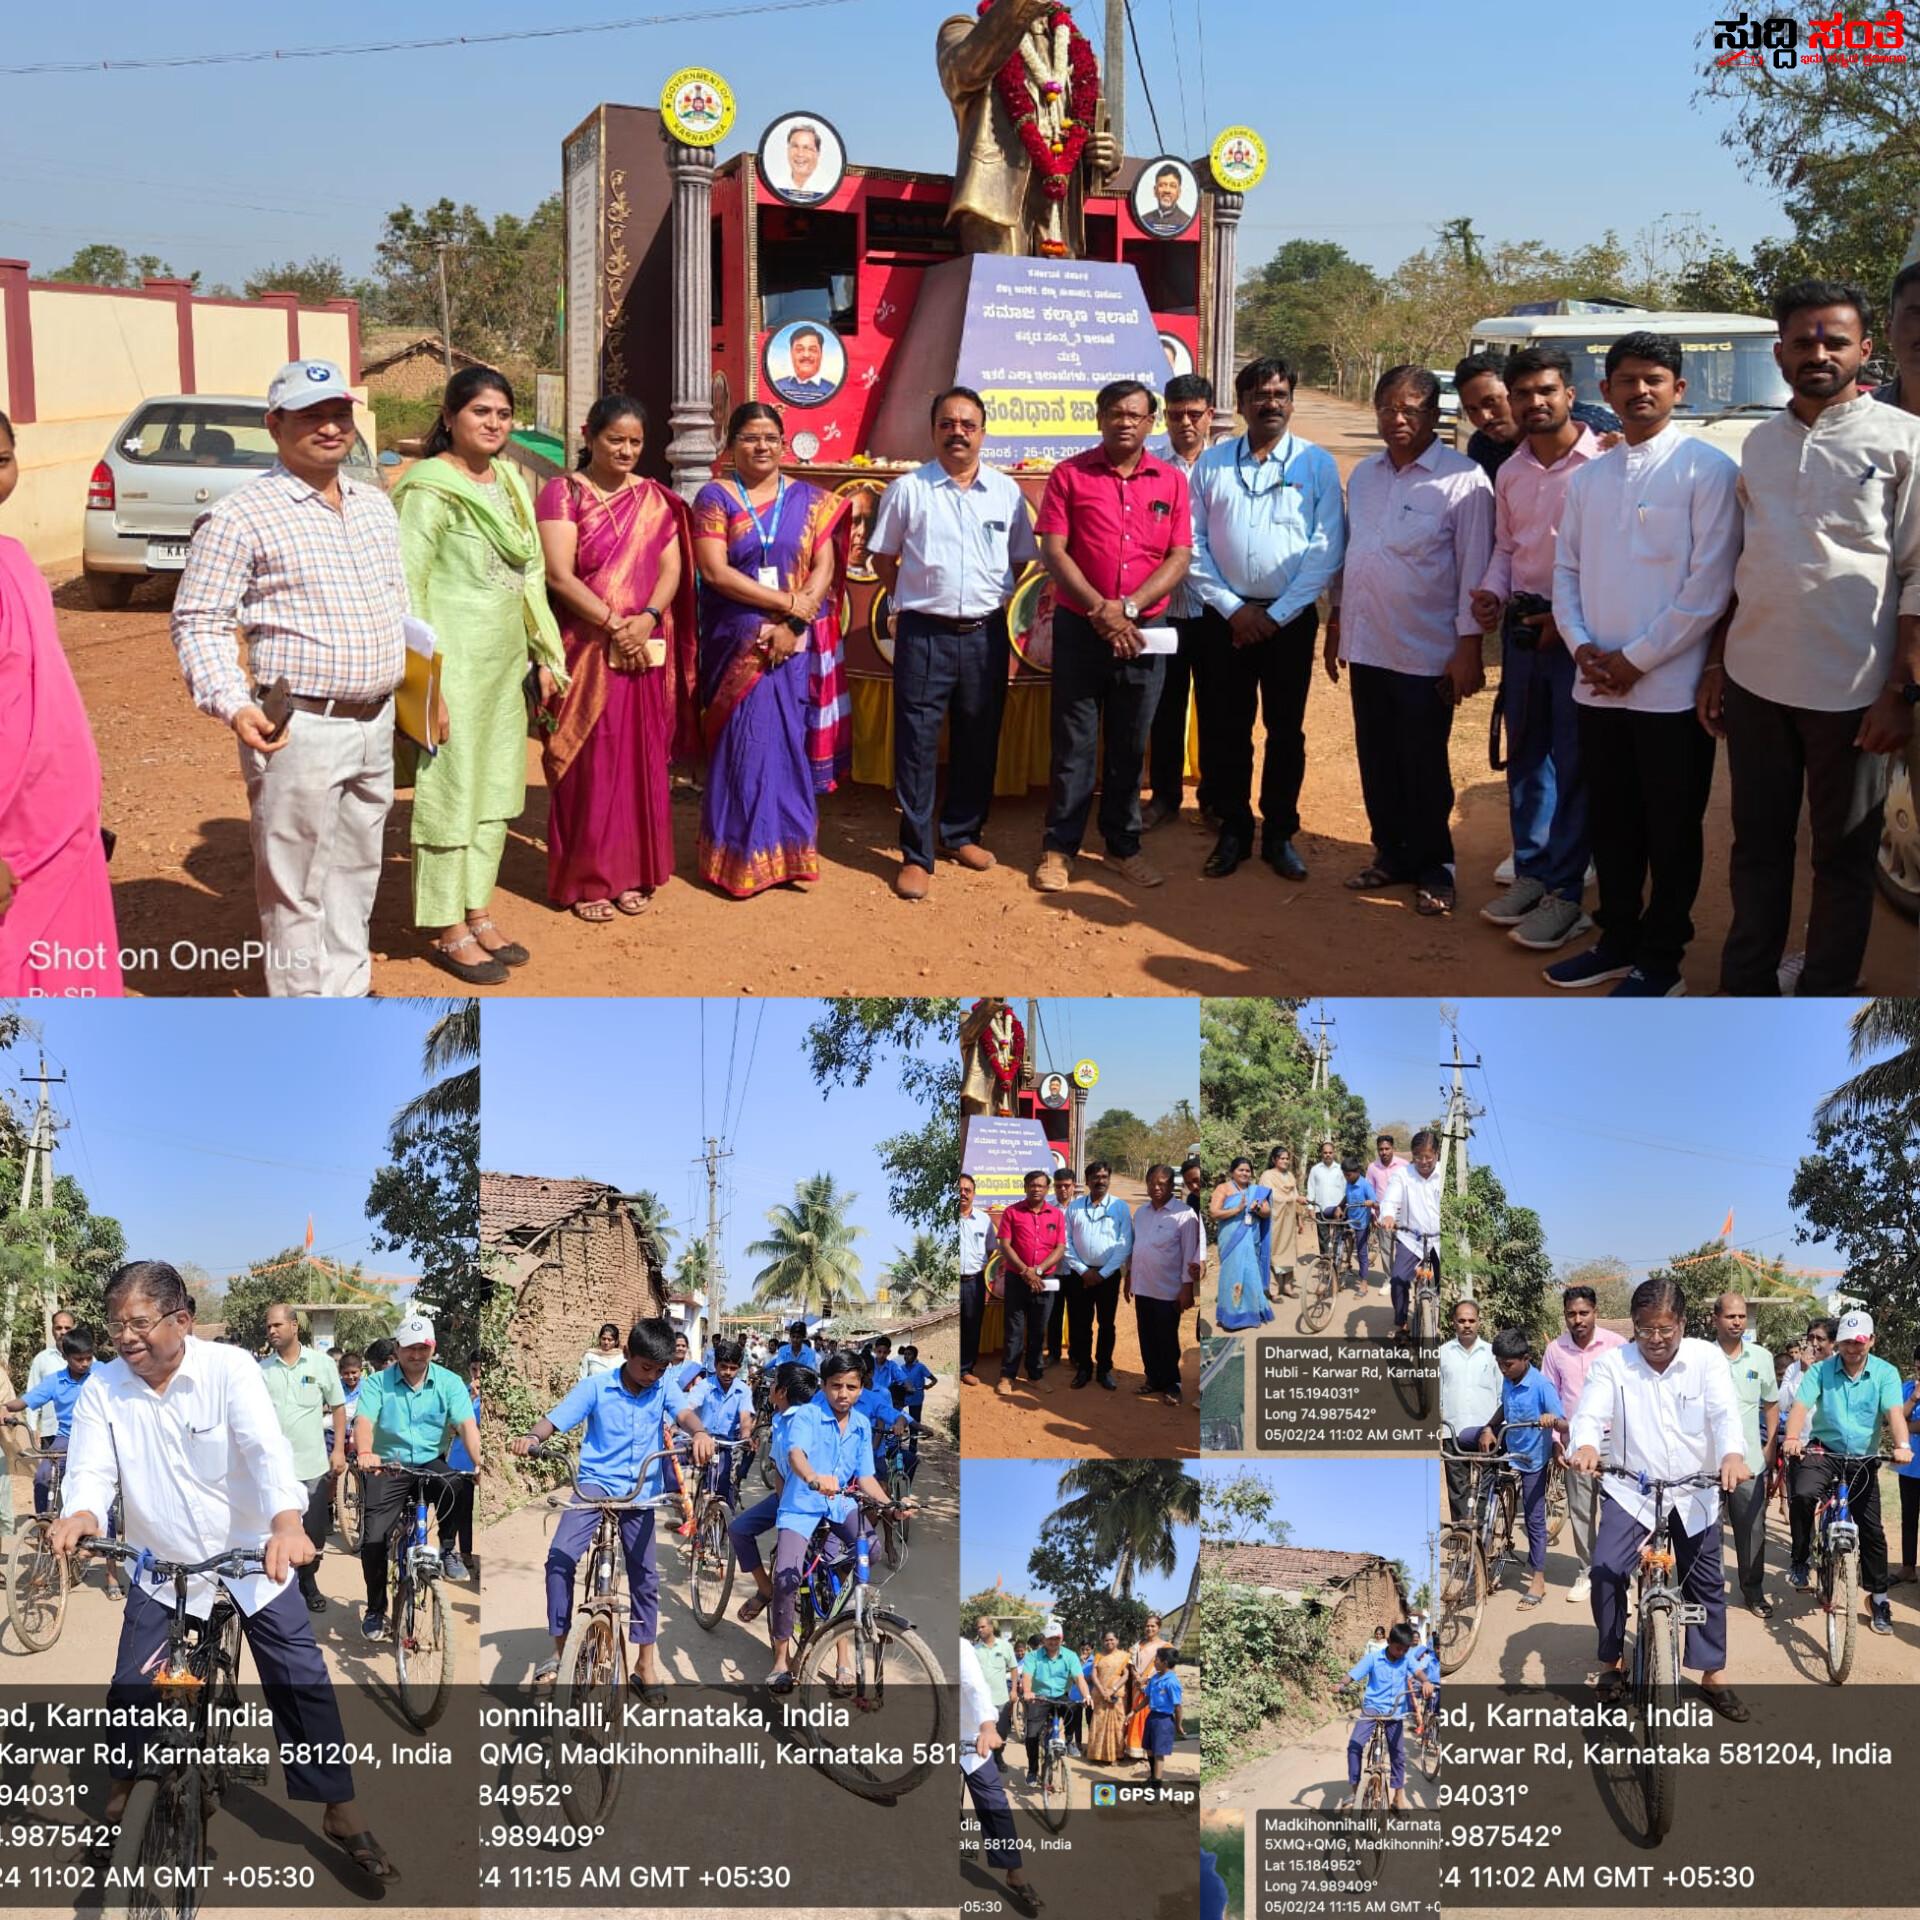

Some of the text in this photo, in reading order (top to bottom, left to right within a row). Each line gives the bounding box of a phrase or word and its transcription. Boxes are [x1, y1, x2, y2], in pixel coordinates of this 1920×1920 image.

[665, 72, 721, 99] GOVERNMENT
[673, 122, 727, 142] KARNATAKA
[983, 303, 1139, 328] ಸಮಾಜ ಕಲ್ಯಾಣ ಇಲಾಖೆ
[983, 396, 1066, 428] ಸಂವಿಧಾನ
